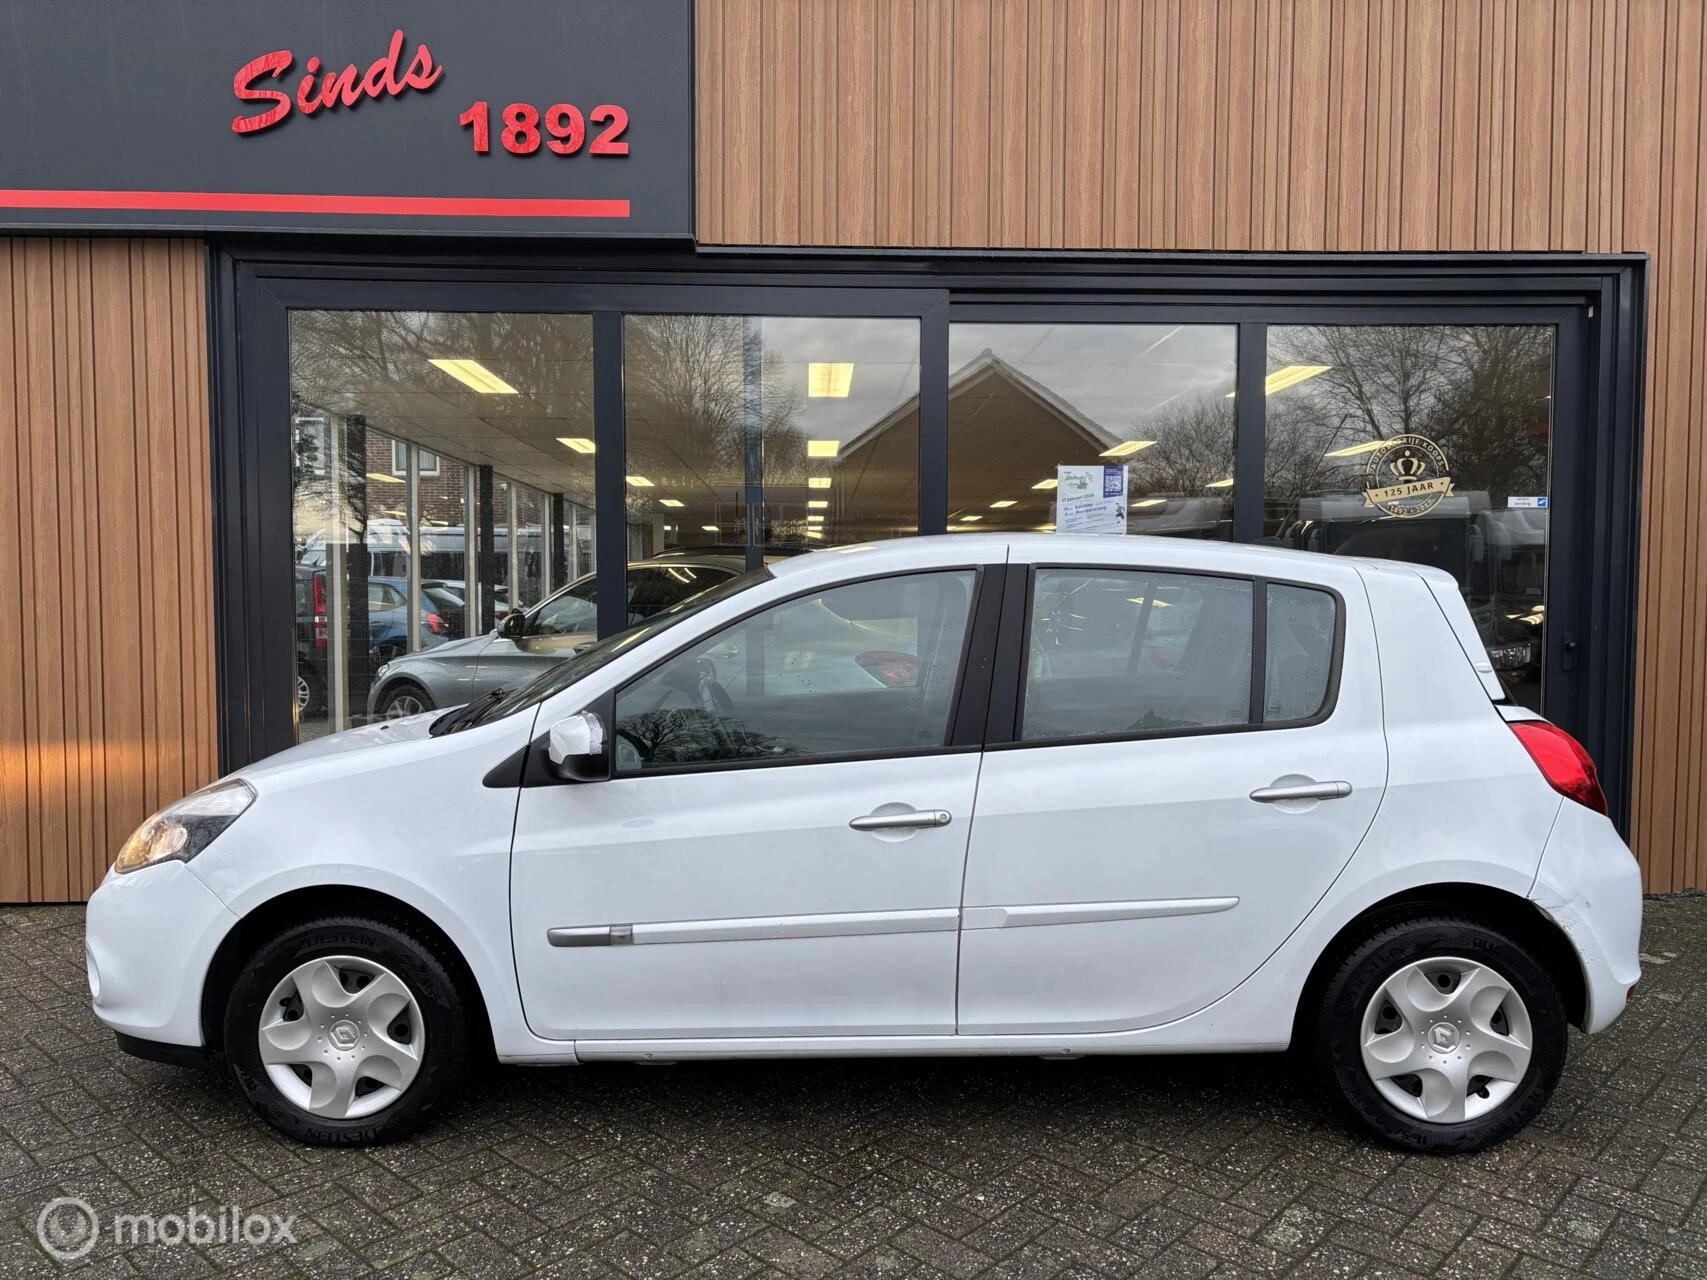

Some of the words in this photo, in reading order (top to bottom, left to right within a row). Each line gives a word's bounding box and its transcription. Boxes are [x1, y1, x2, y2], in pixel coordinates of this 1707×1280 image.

[232, 29, 443, 135] Sinds
[459, 101, 630, 155] 1892
[1422, 441, 1445, 466] KOOPS
[1383, 487, 1403, 498] 125
[1406, 481, 1434, 495] JAAR
